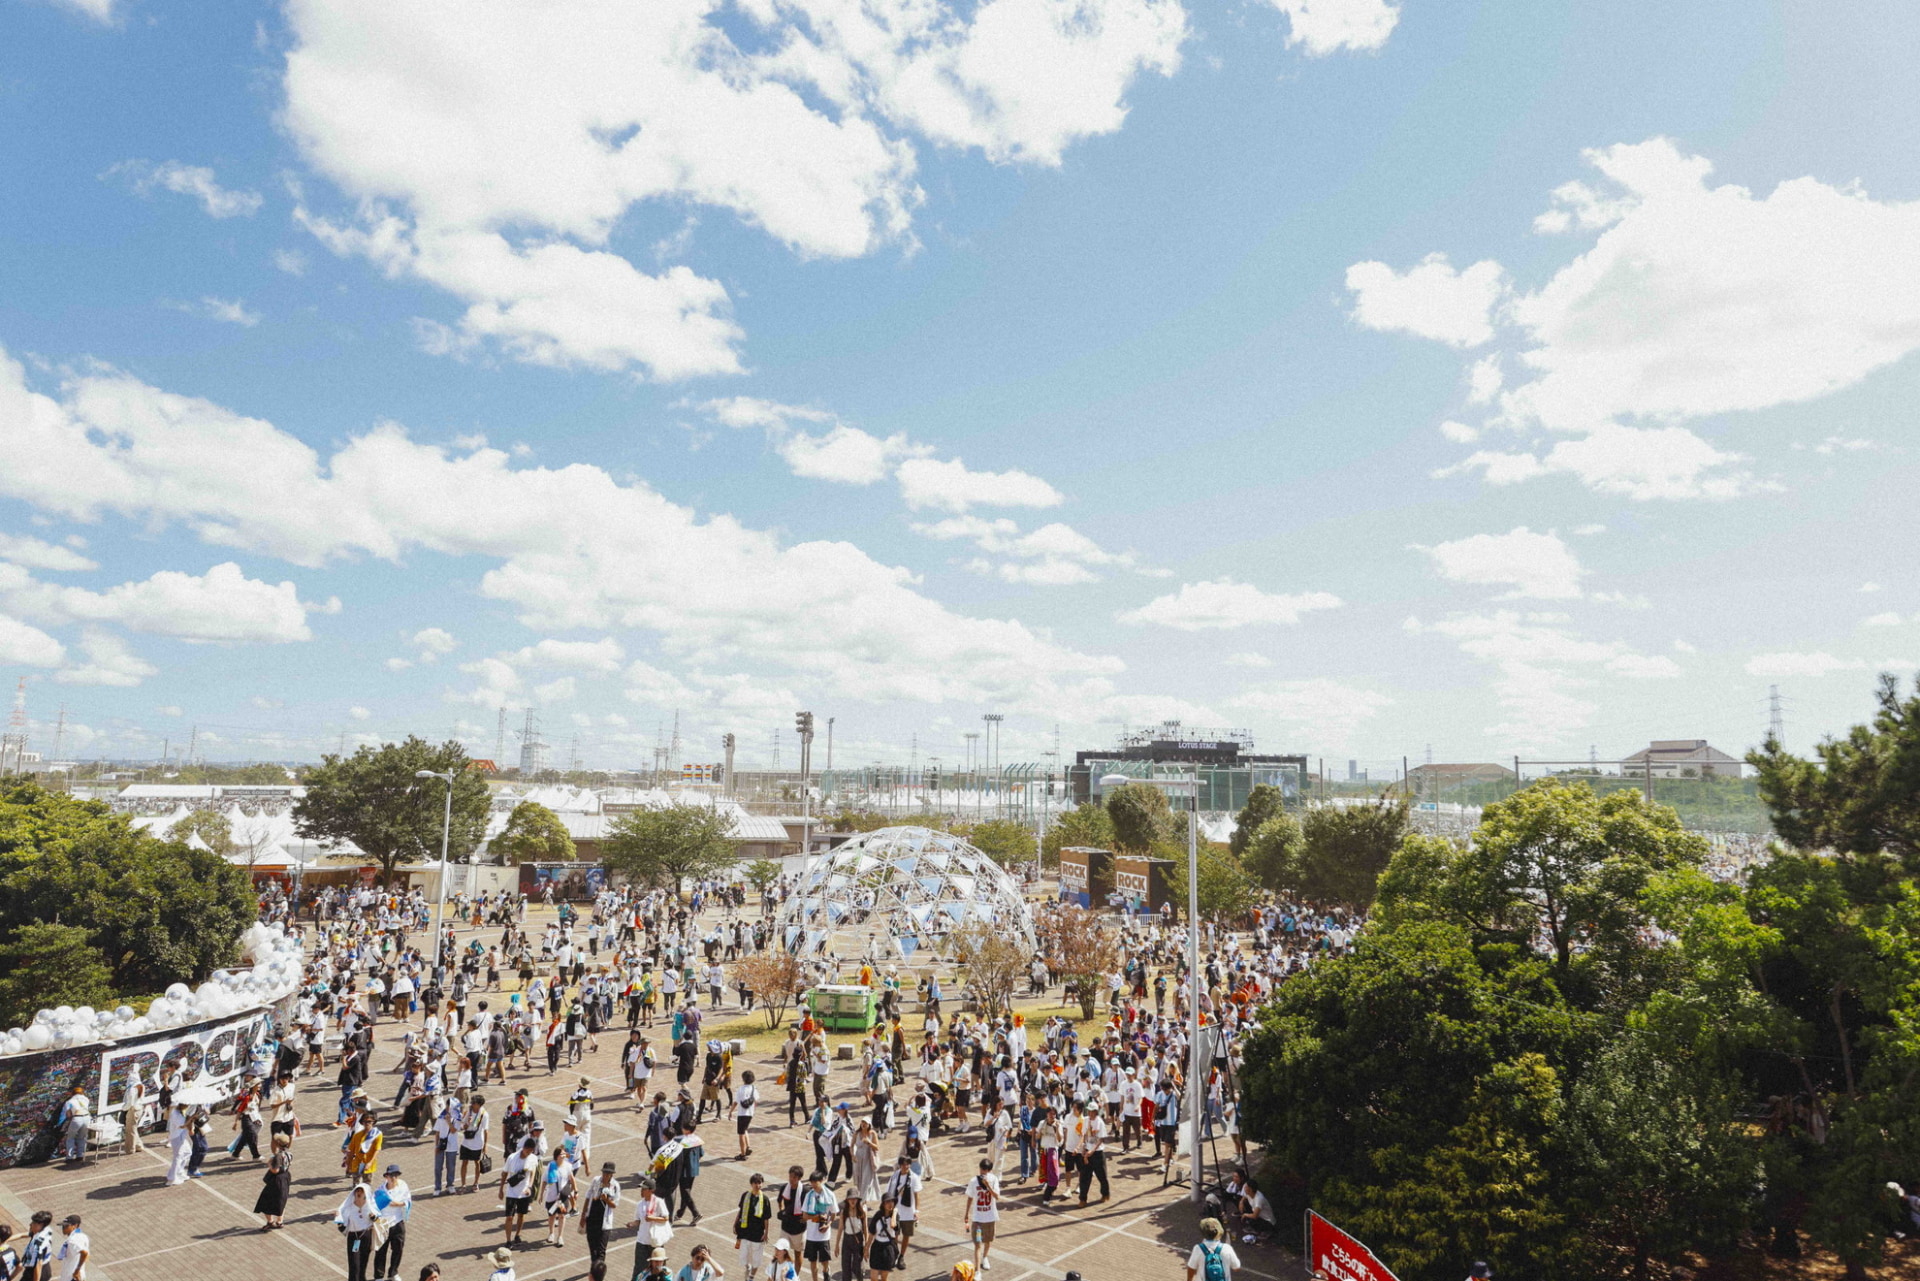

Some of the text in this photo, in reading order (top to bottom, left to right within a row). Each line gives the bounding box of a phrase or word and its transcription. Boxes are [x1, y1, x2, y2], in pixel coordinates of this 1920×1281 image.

[1199, 742, 1218, 750] STAGE
[1062, 863, 1086, 879] ROCK
[1118, 874, 1146, 891] ROCK
